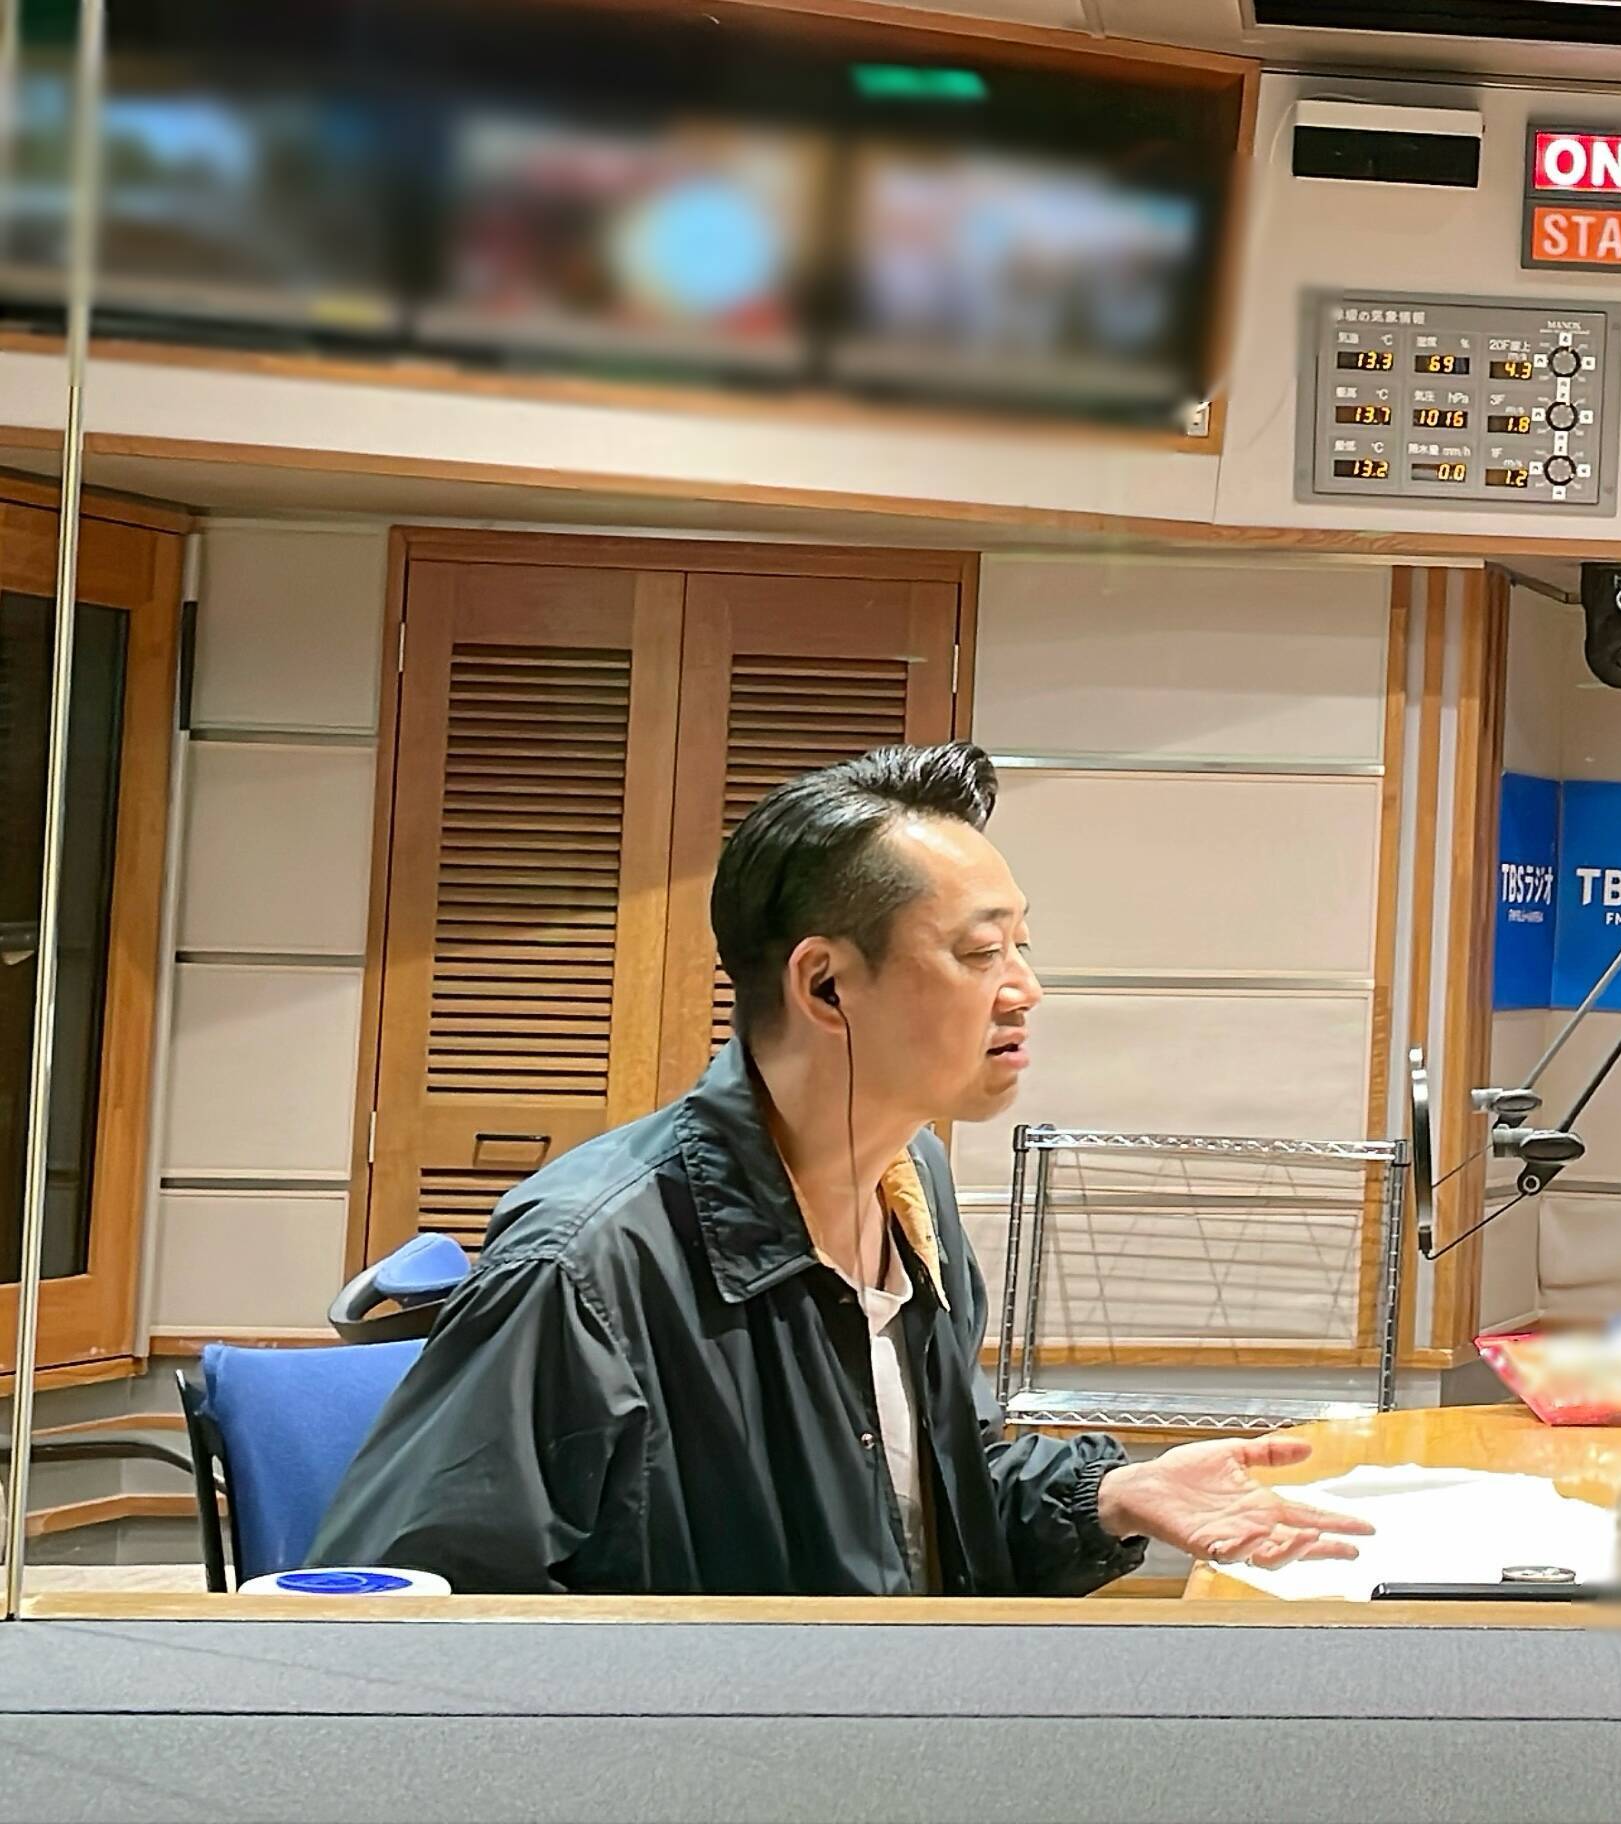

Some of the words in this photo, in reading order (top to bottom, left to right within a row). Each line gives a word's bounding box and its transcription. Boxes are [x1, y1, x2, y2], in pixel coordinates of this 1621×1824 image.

[1358, 352, 1393, 370] 13.3
[1429, 355, 1454, 373] 69
[1505, 362, 1532, 379] 4.3
[1355, 406, 1391, 423] 13.7
[1420, 409, 1464, 427] 1016
[1507, 416, 1530, 433] 1.8
[1353, 460, 1389, 478] 13.2
[1438, 463, 1466, 481] 0.0
[1505, 469, 1528, 487] 1.2
[1501, 863, 1554, 906] TBSラジオ
